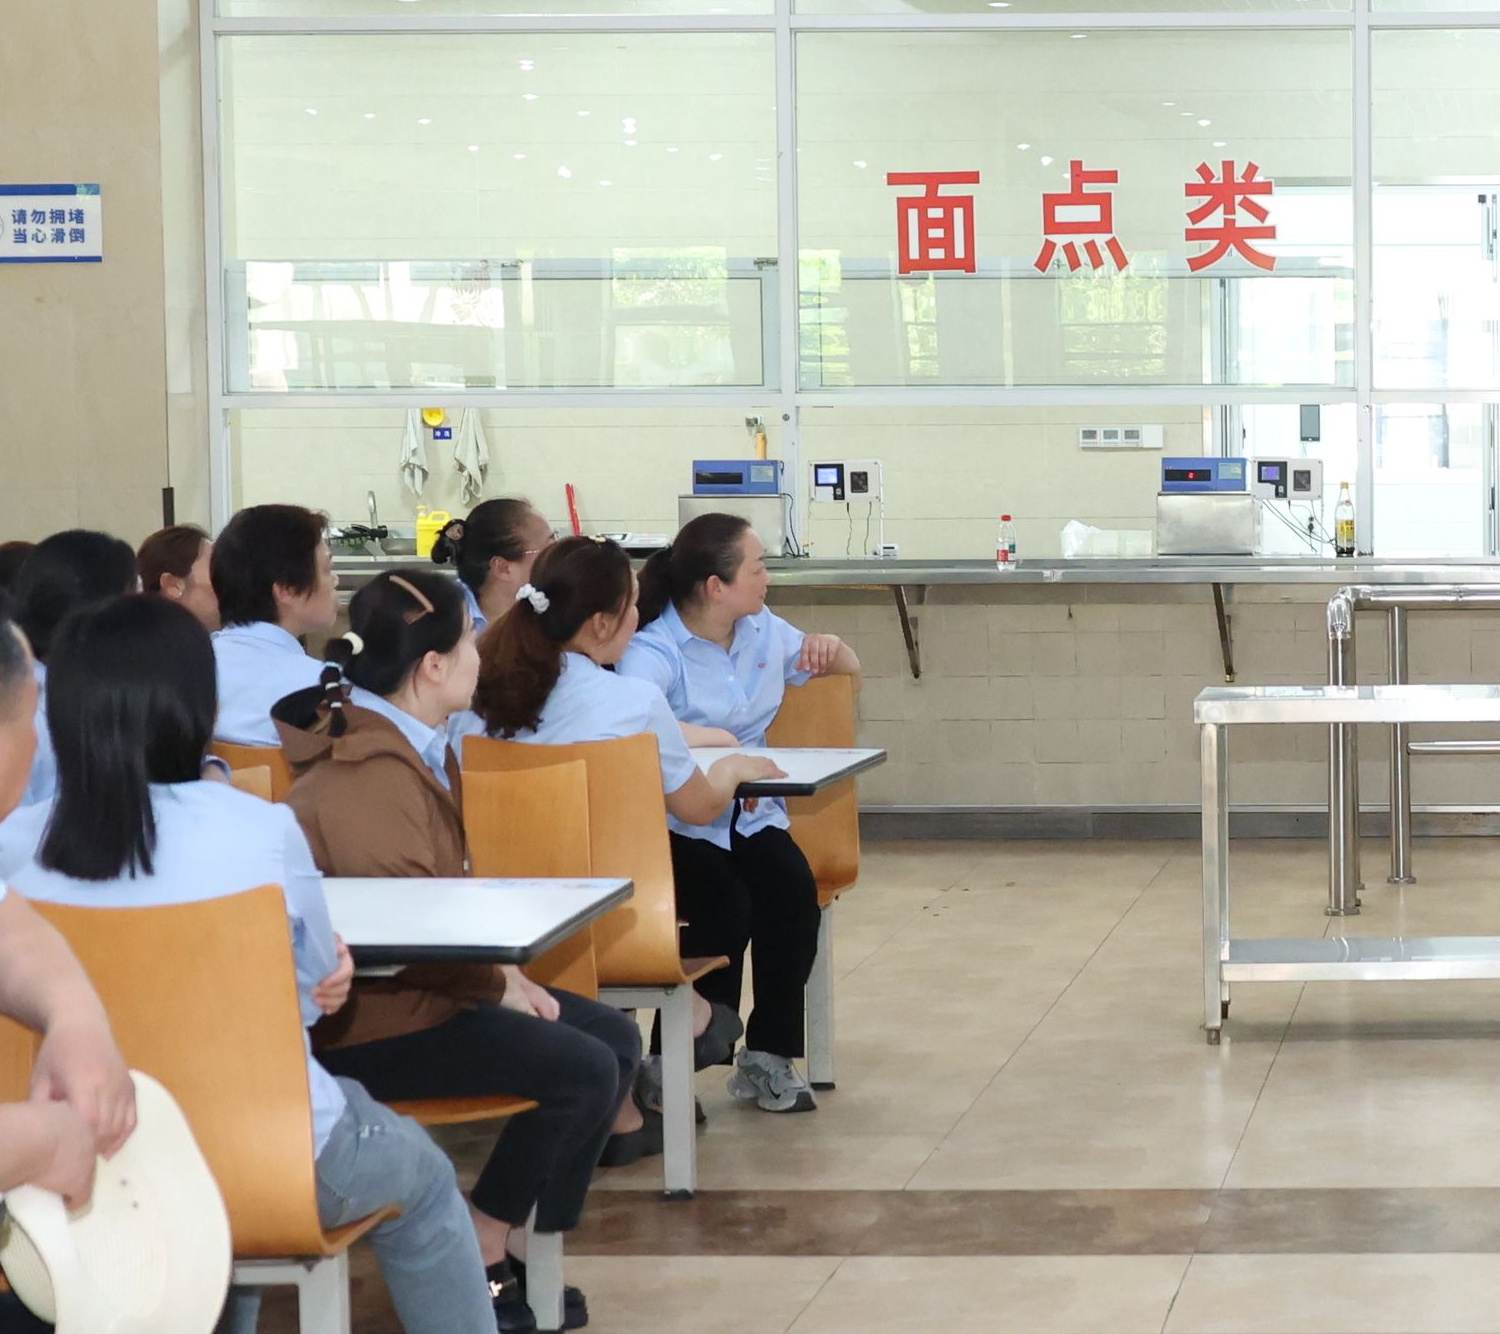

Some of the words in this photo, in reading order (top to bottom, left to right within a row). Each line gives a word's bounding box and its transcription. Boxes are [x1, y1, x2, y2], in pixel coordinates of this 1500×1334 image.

[11, 208, 85, 225] 请勿拥堵
[886, 160, 1277, 275] 面点类
[12, 228, 86, 244] 当心滑倒
